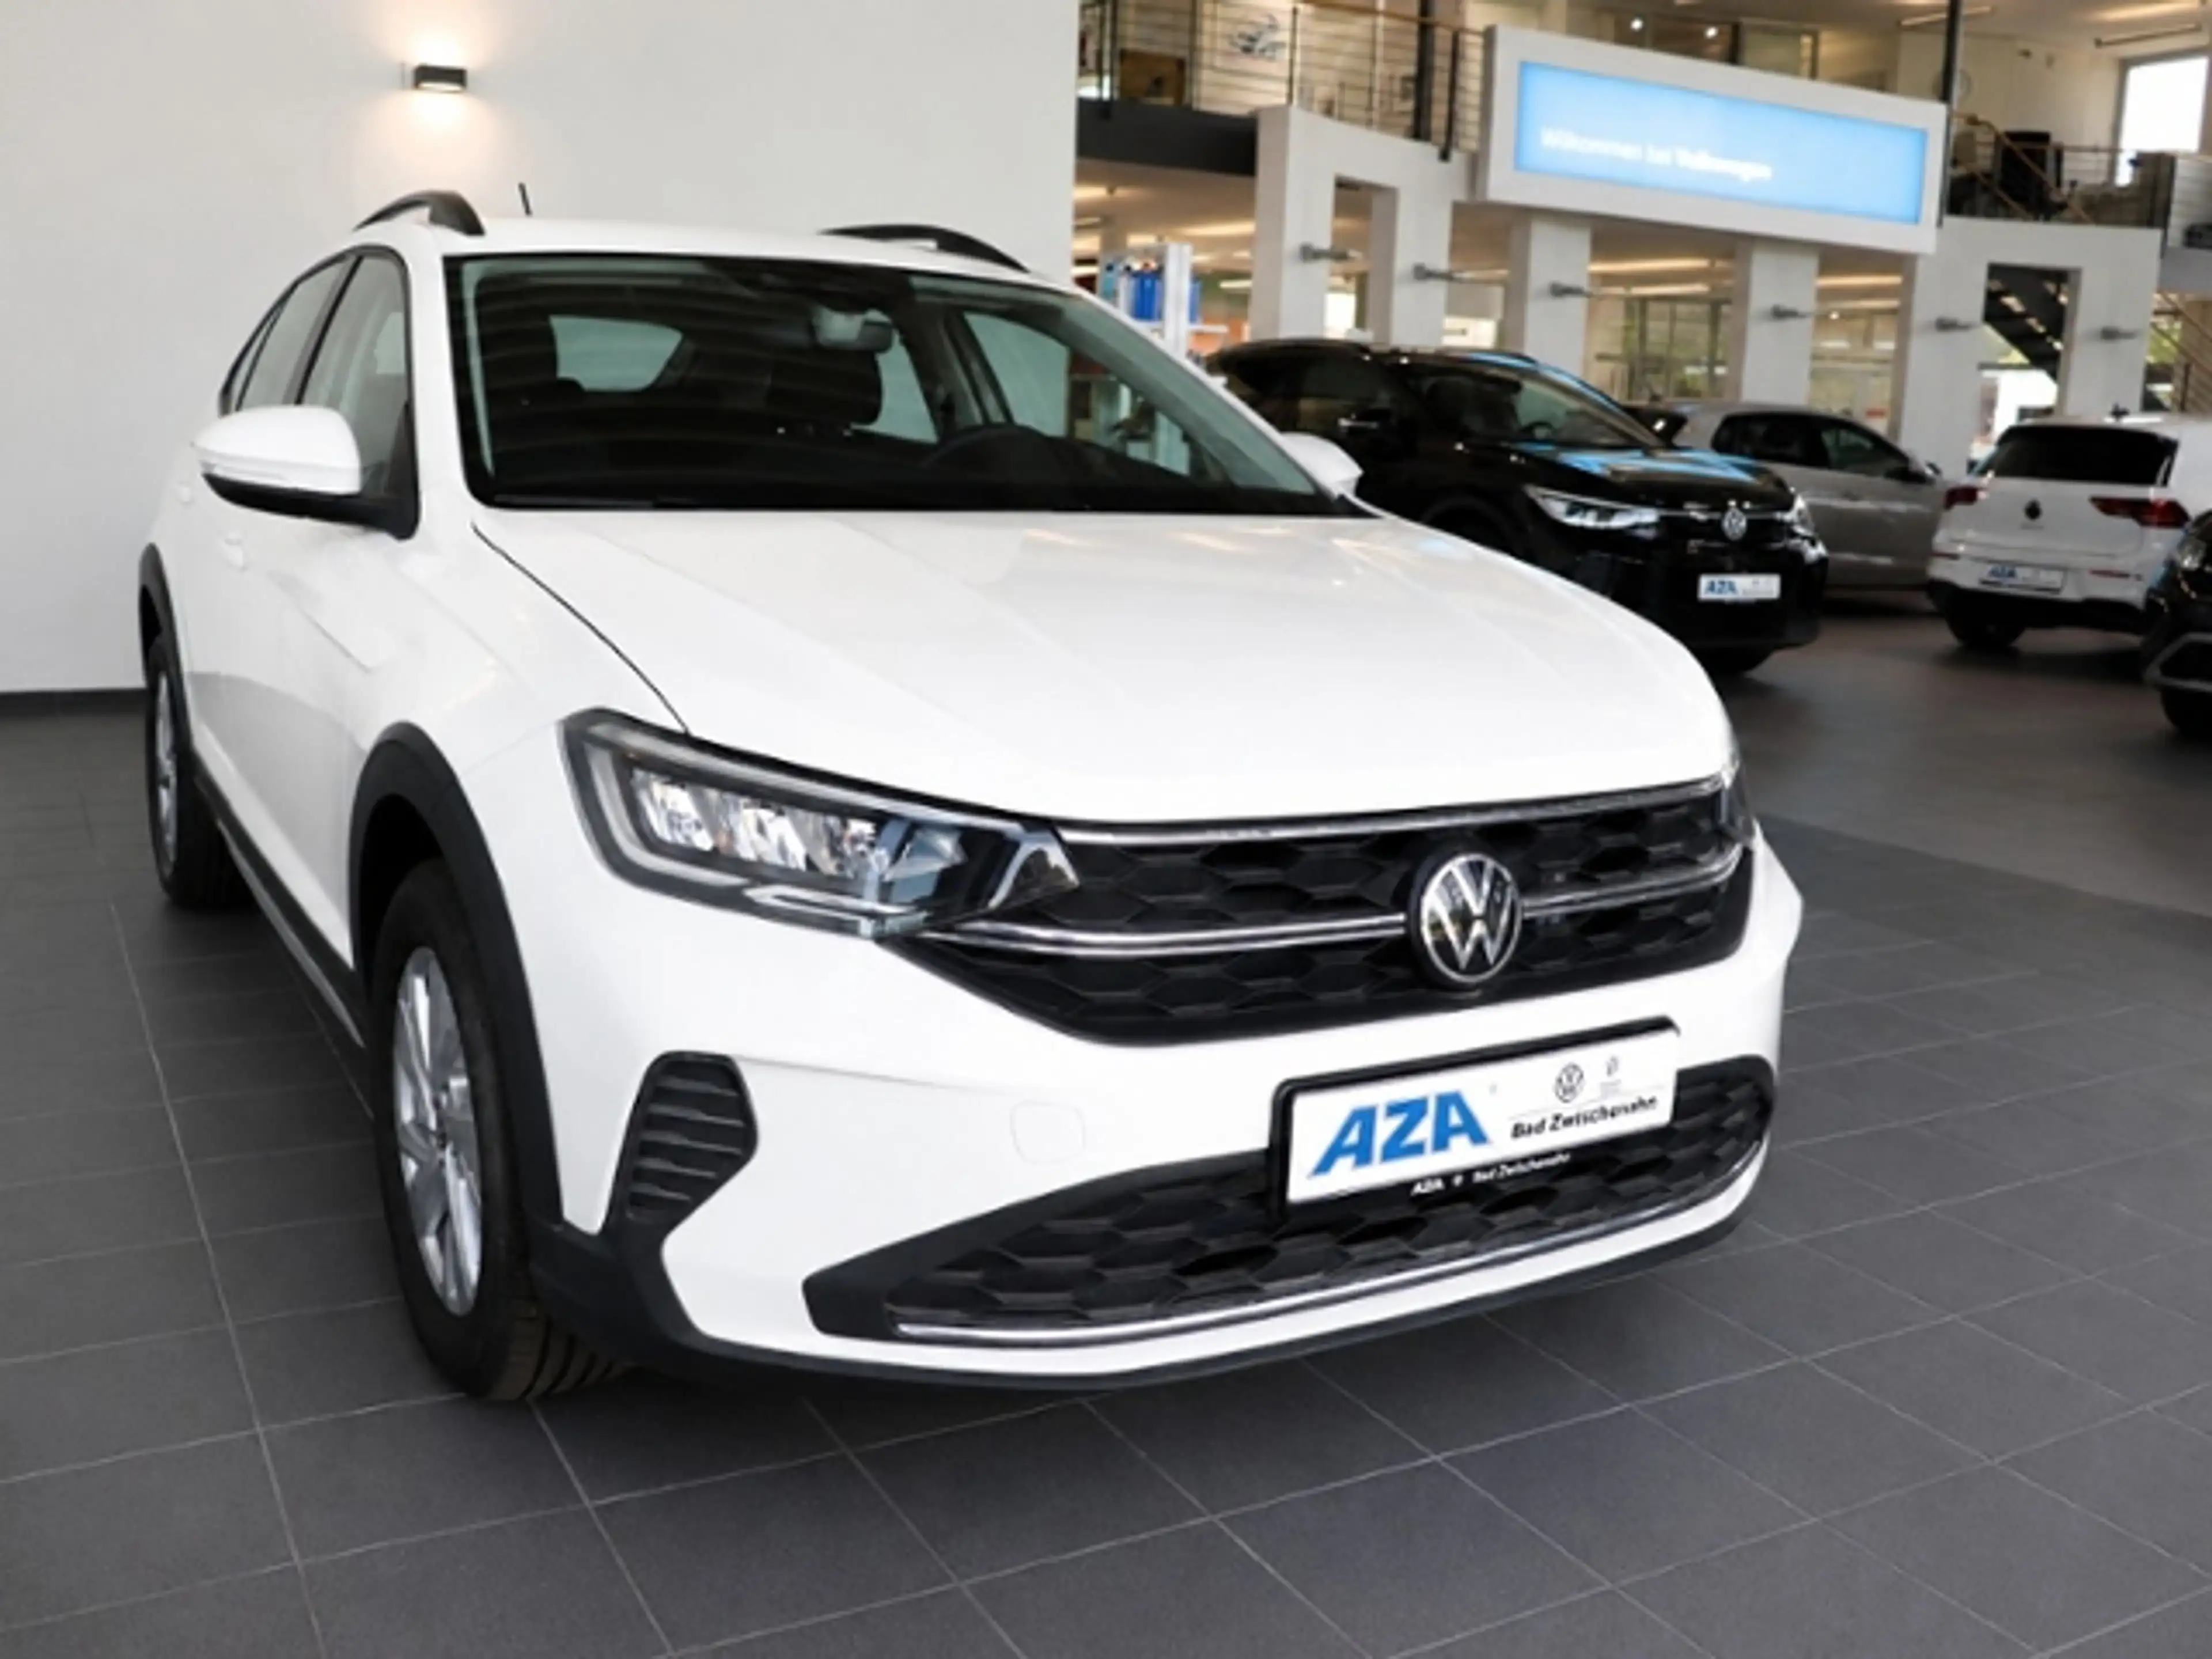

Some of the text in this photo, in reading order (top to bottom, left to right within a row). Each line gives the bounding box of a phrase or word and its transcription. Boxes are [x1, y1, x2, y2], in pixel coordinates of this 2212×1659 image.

[1704, 580, 1739, 595] AZA
[1308, 1090, 1492, 1177] AZA
[1511, 1118, 1546, 1138] Bad
